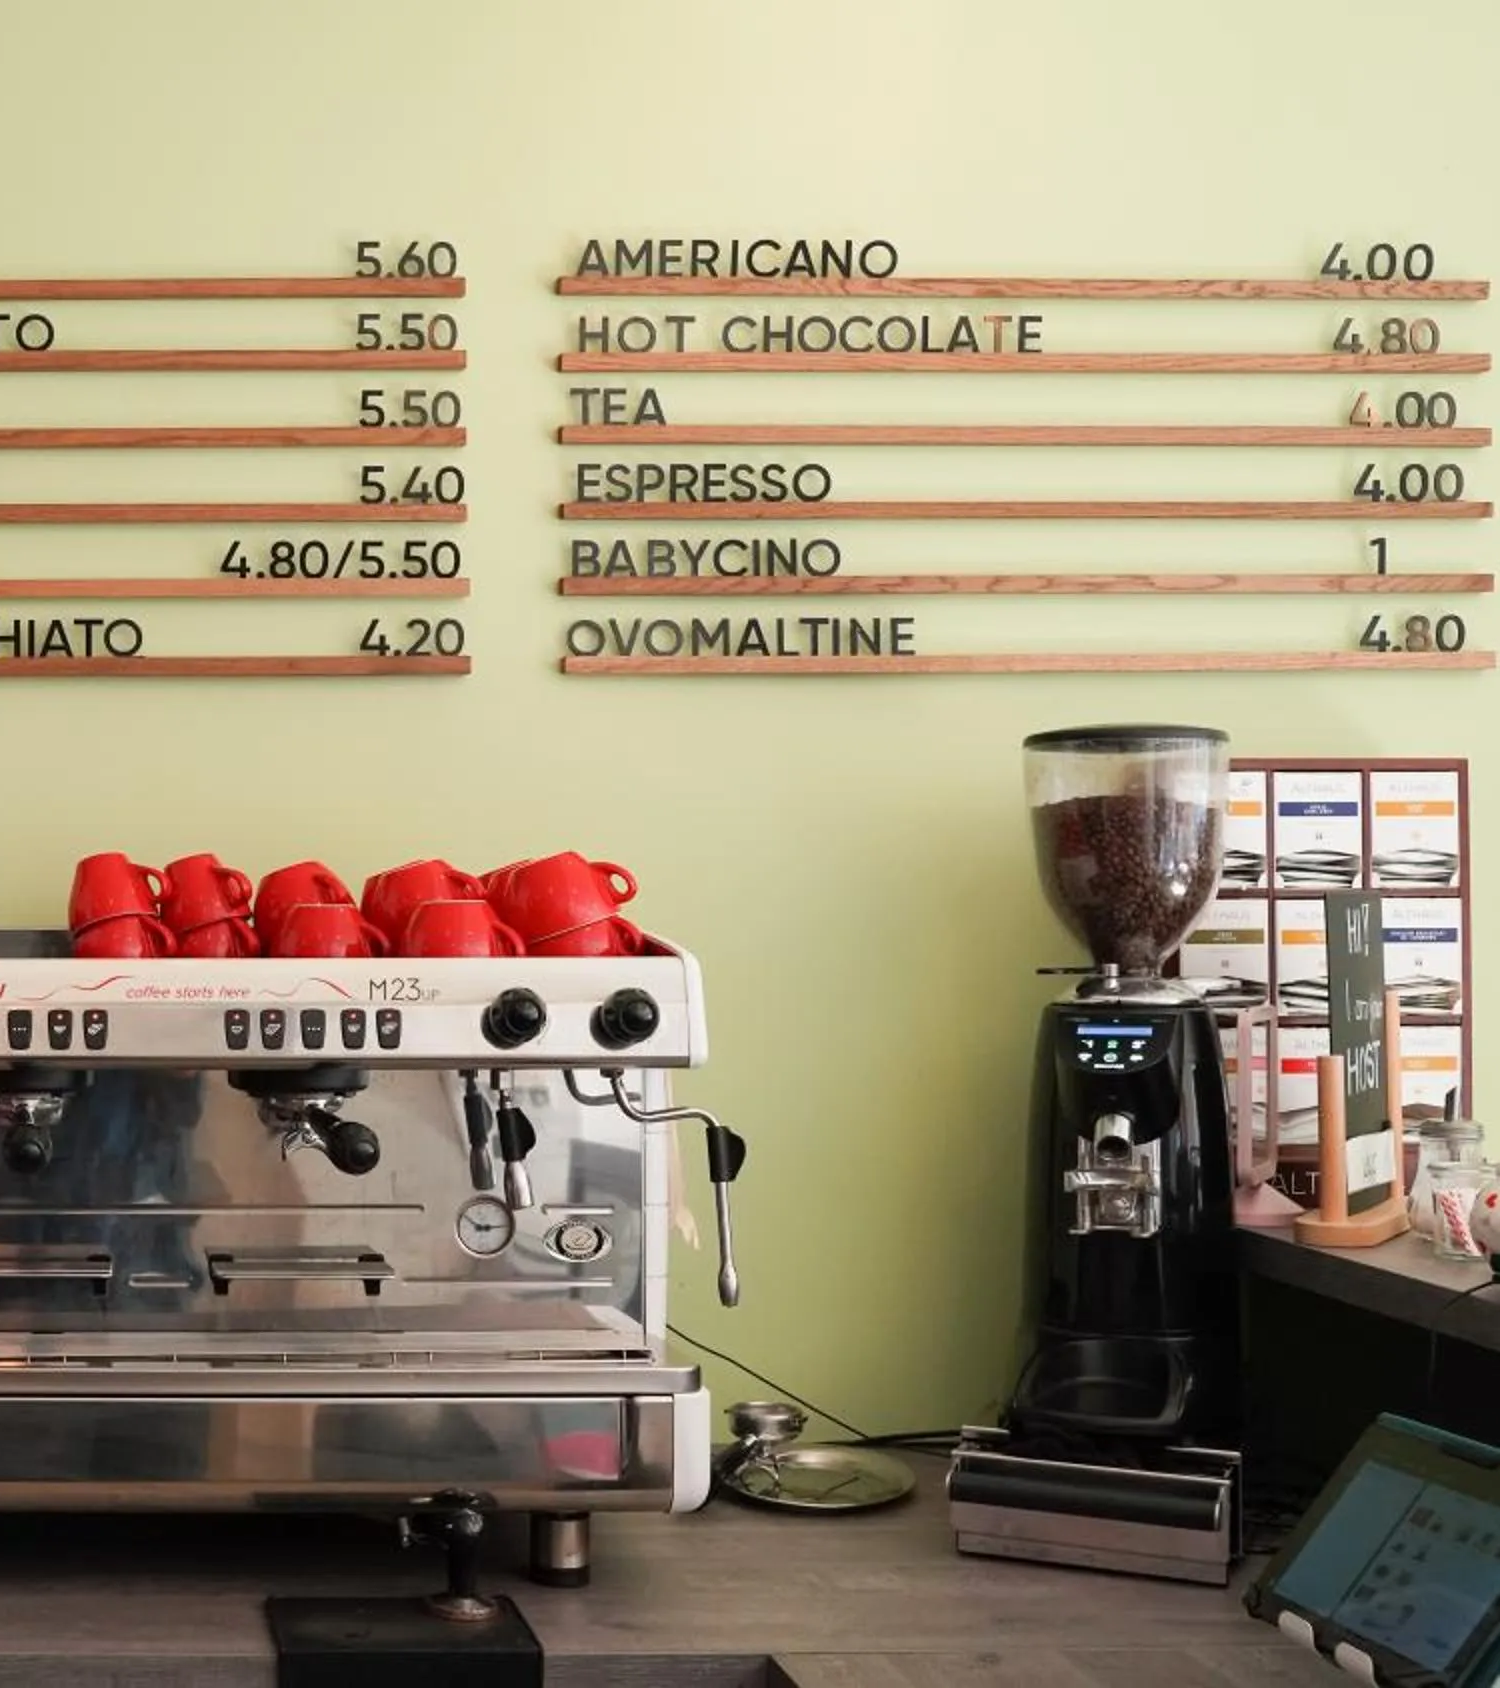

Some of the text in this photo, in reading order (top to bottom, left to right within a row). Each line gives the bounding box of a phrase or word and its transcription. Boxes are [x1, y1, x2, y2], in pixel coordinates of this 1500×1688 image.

[354, 241, 457, 279] 5.60
[576, 239, 1434, 282] AMERICANO 4.00
[355, 313, 458, 351] 5.50
[577, 315, 1439, 356] HOT CHOCOLATE 4.80
[358, 390, 461, 428] 5.50
[570, 388, 1457, 430] TEA 4.00
[359, 466, 465, 505] 5.40
[576, 464, 1464, 503] ESPRESSO 4.00
[220, 540, 461, 580] 4.80/5.50
[570, 537, 1388, 578] BABYCINO 1
[359, 619, 465, 657] 4.20
[566, 615, 1466, 657] OVOMALTINE 4.80
[125, 984, 251, 999] coffee starts here
